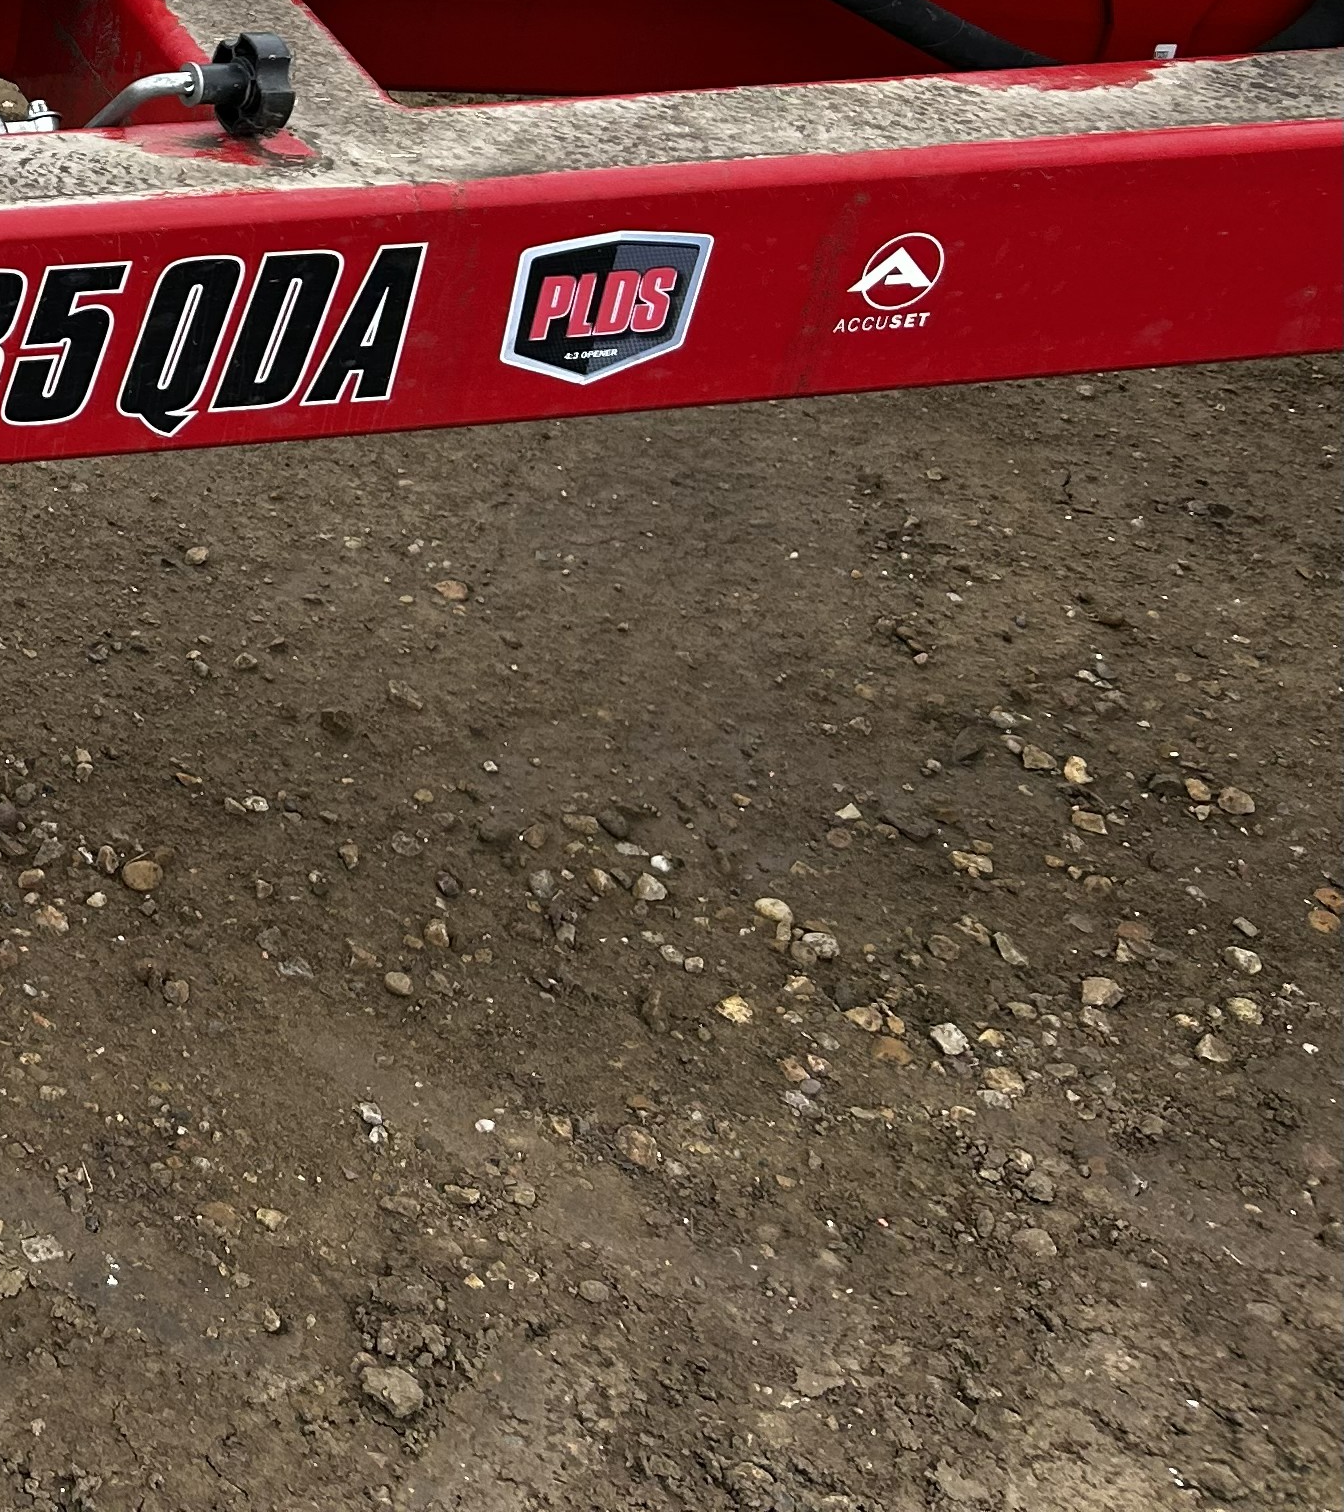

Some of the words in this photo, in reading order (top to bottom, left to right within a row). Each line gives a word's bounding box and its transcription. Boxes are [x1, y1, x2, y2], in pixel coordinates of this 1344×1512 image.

[528, 267, 679, 341] PLDS
[833, 312, 931, 333] ACCUSET
[581, 348, 618, 359] OPENER
